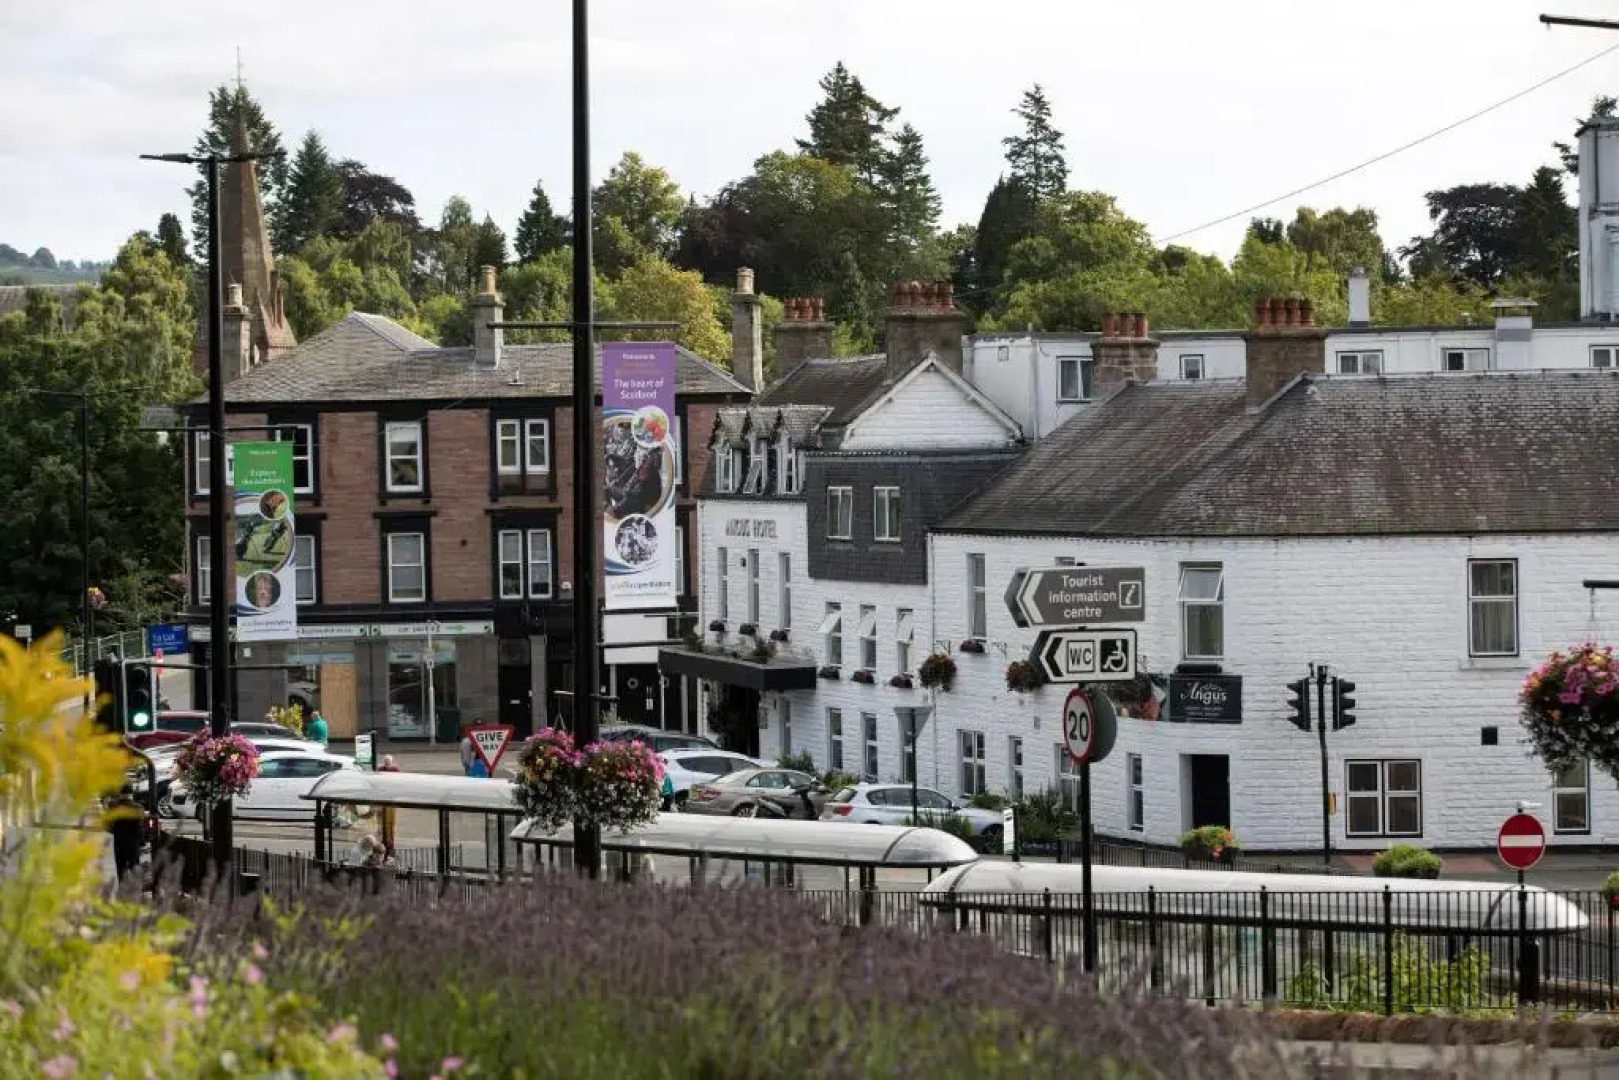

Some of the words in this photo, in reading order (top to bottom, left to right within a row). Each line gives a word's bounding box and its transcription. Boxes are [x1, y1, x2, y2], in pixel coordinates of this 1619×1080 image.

[614, 379, 629, 389] The
[630, 379, 654, 389] heart
[655, 377, 664, 388] of
[620, 389, 657, 399] Scotland
[753, 519, 778, 538] HOTEL
[1062, 574, 1104, 588] Tourist
[1049, 590, 1117, 603] information
[1063, 606, 1102, 618] centre
[1069, 647, 1093, 666] WC
[1068, 710, 1089, 743] 20
[475, 731, 504, 742] GIVE
